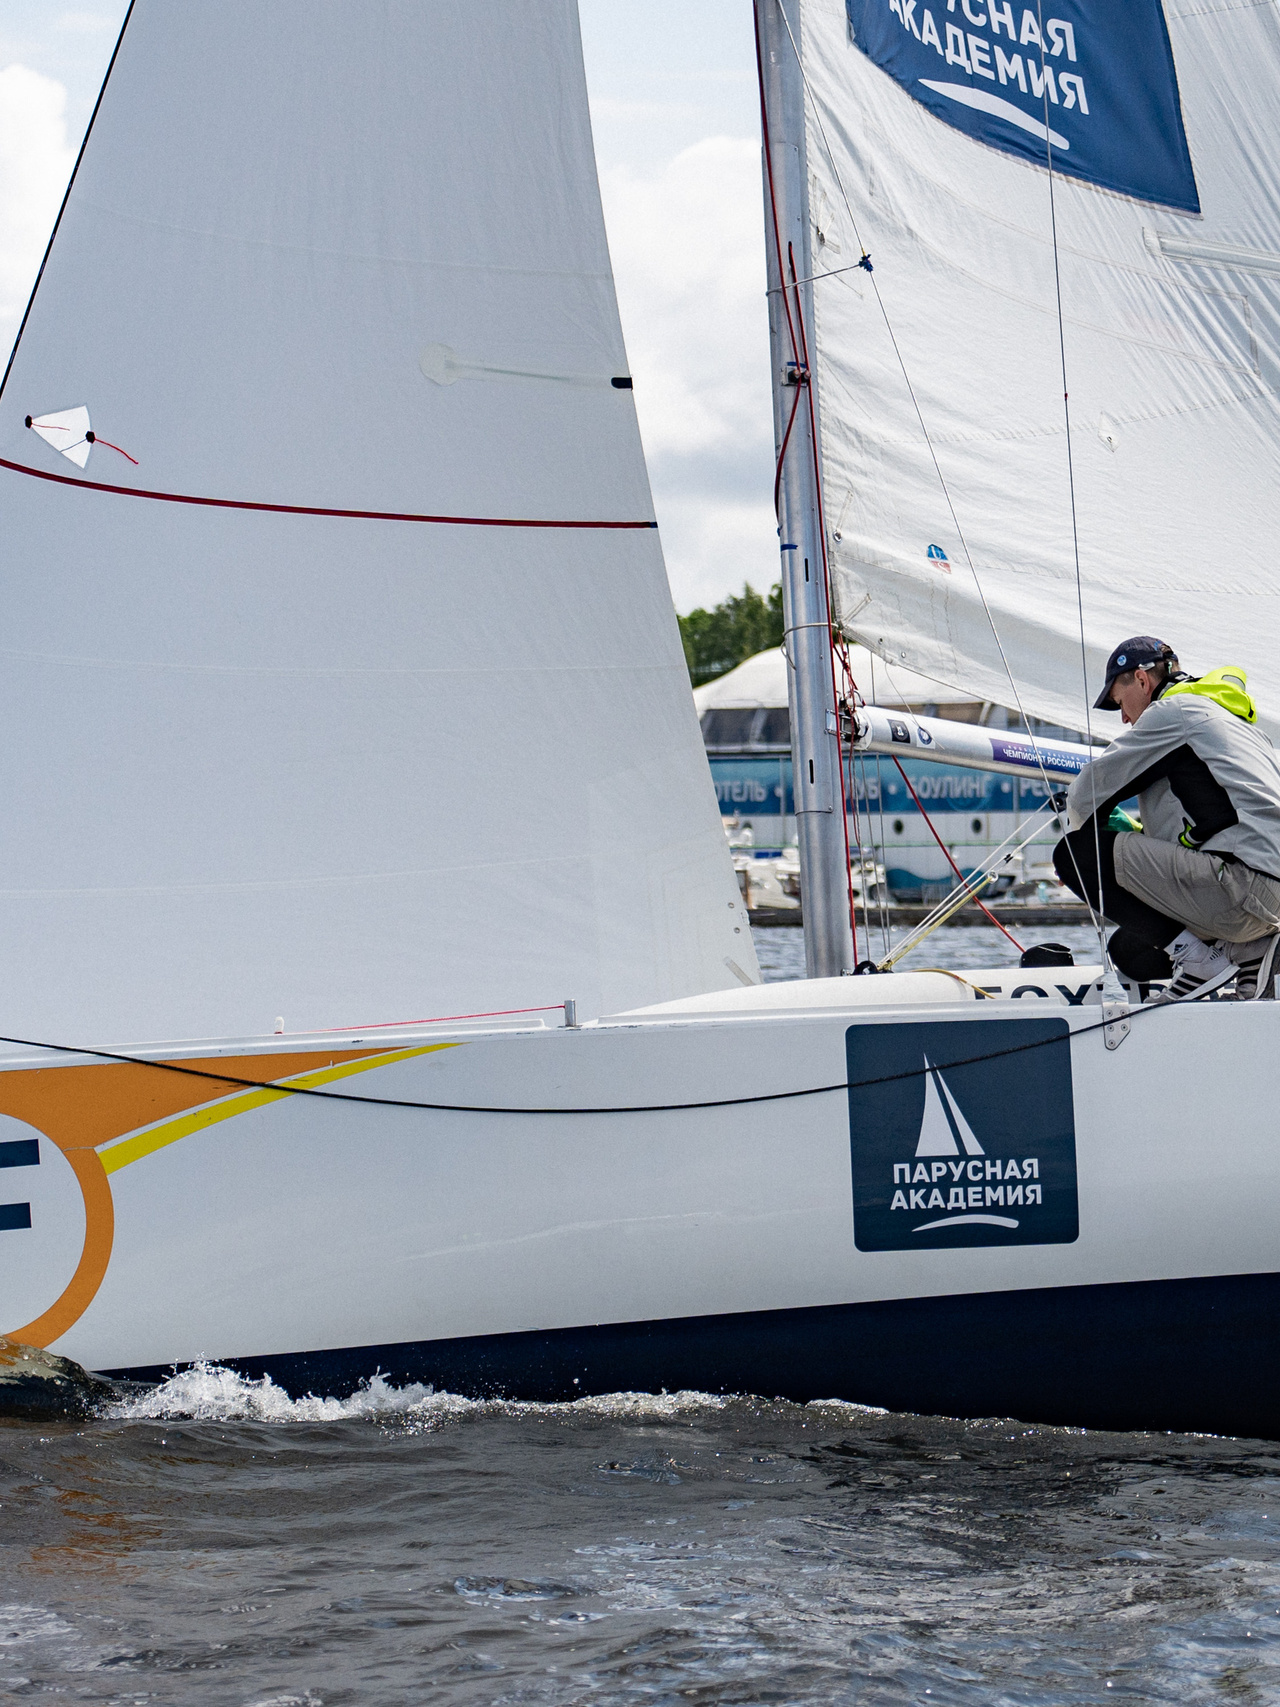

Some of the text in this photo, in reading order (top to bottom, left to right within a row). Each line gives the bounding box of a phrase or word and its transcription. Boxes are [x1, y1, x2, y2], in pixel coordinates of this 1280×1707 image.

[1047, 756, 1076, 769] РОССИИ
[845, 778, 879, 800] ЛУБ
[906, 774, 993, 800] БОУЛИНГ
[892, 1158, 1039, 1184] ПАРУСНАЯ
[890, 1184, 1042, 1210] АКАДЕМИЯ
